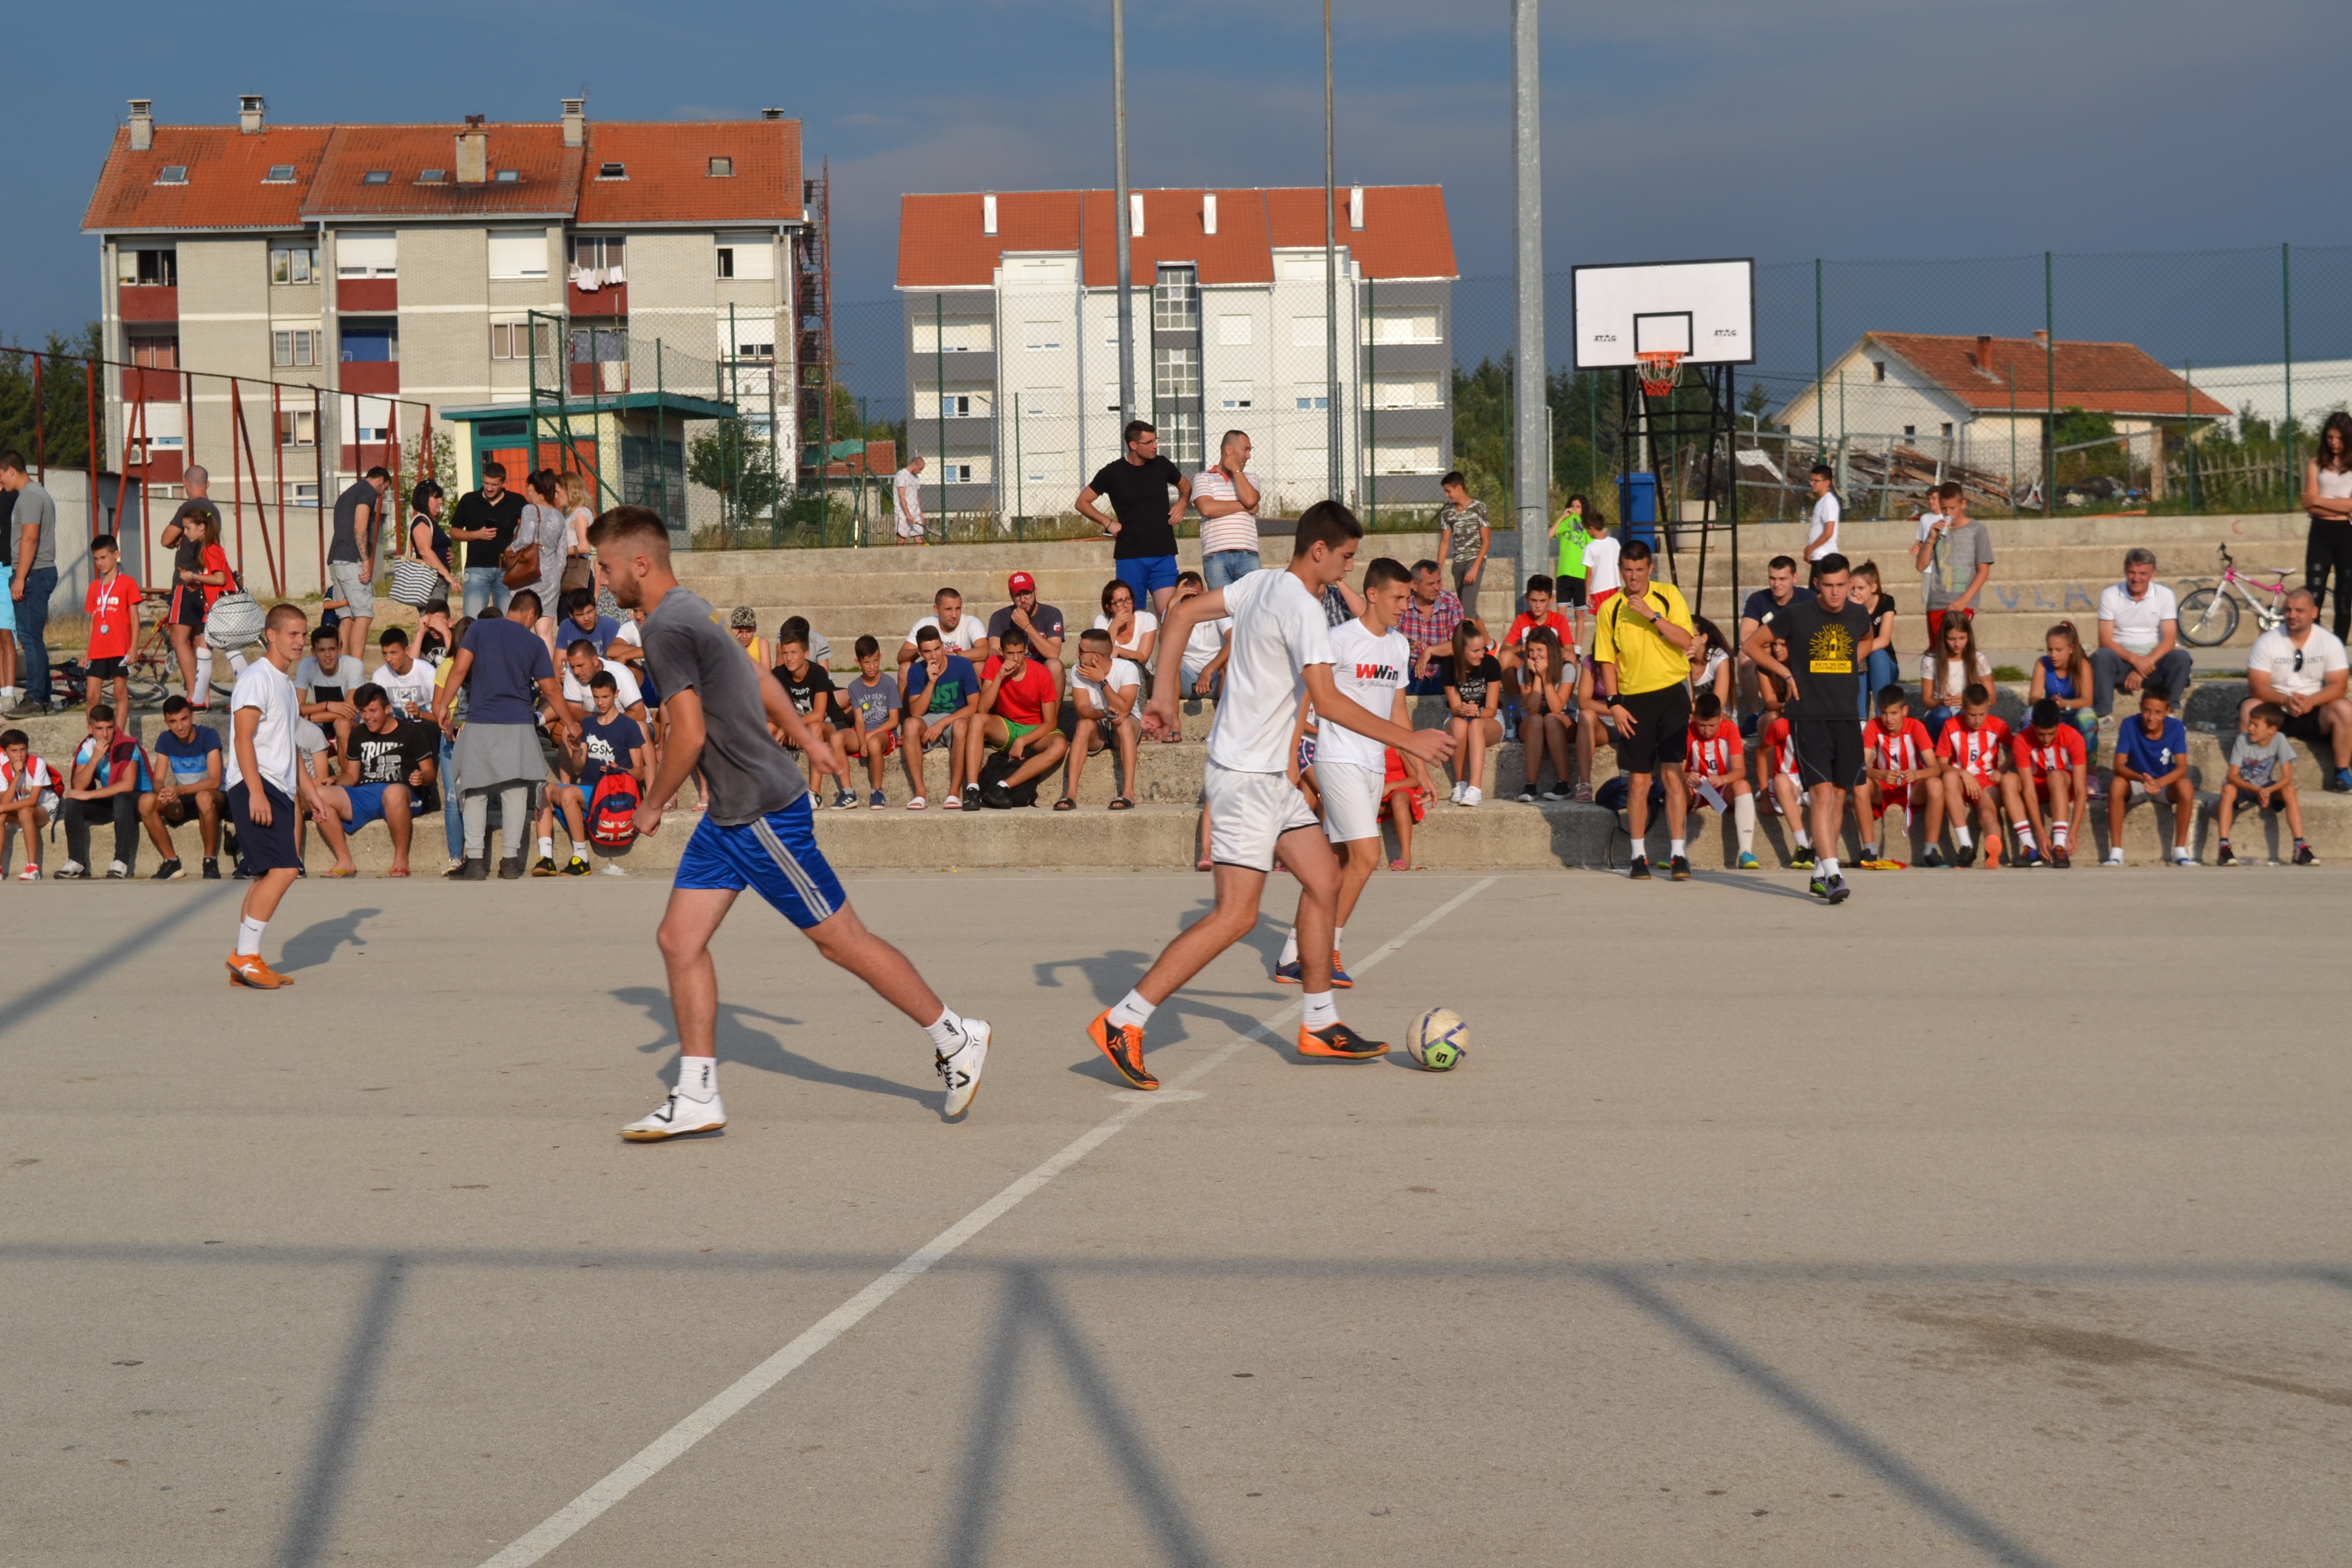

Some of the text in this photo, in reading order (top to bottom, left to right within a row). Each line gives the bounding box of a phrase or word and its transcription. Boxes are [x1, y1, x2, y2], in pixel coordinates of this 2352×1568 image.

[1356, 664, 1399, 681] WWin
[392, 688, 418, 702] KEEP
[930, 681, 959, 704] UST
[590, 743, 615, 755] GSM
[1971, 749, 1978, 762] 6
